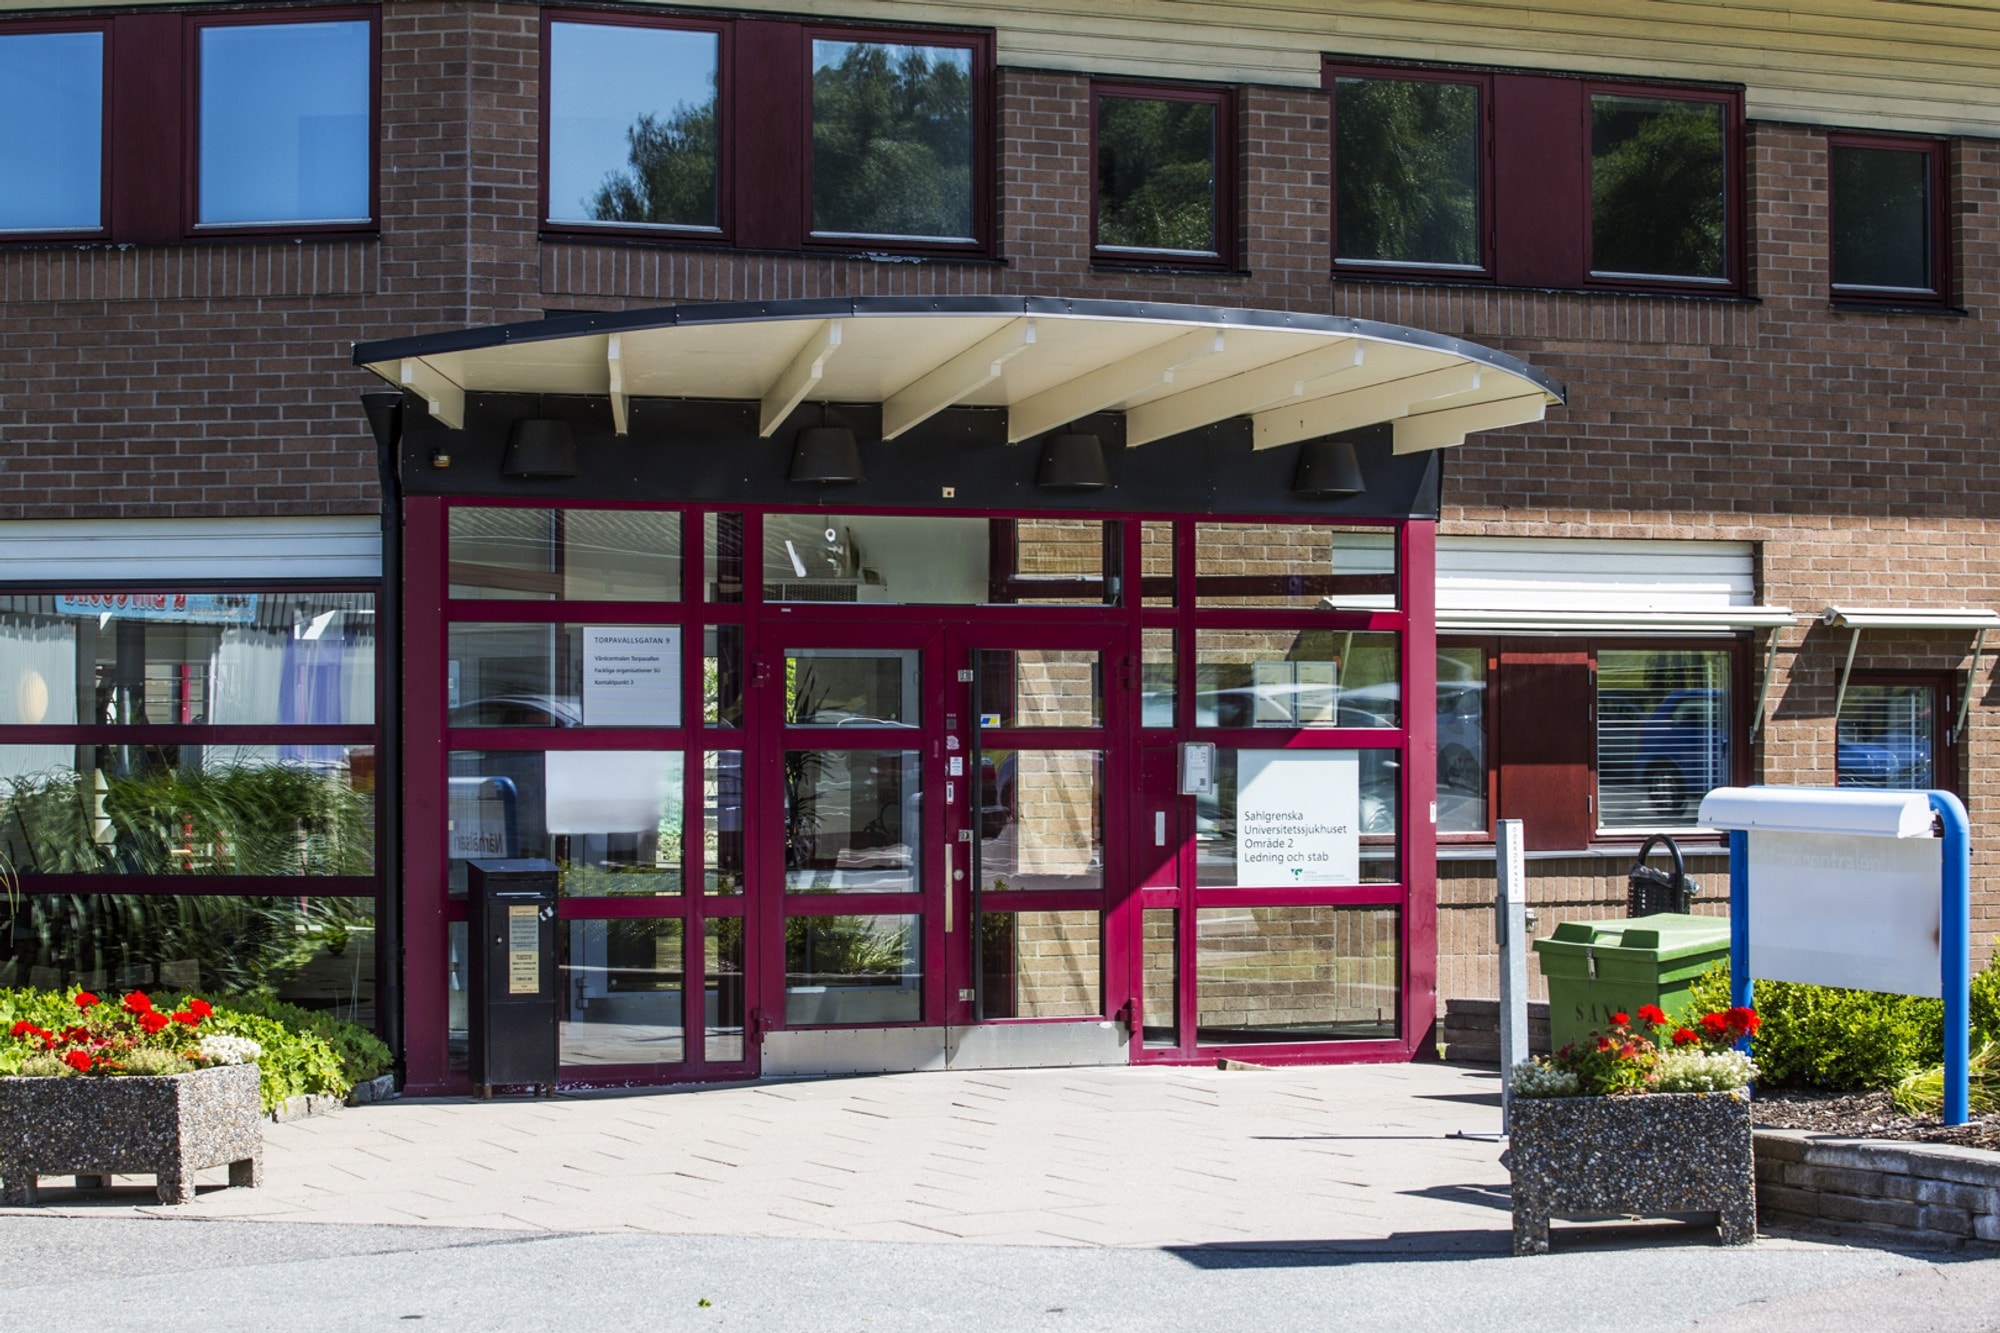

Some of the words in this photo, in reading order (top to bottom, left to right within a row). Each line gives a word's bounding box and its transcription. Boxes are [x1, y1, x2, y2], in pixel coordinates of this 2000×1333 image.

[1244, 811, 1303, 823] Sahlgrenska
[1244, 824, 1347, 836] Universitetssjukhuset
[1244, 838, 1285, 849] Område
[1288, 838, 1294, 848] 2
[1244, 852, 1284, 864] Ledning
[1287, 852, 1304, 862] och
[1307, 852, 1329, 862] stab
